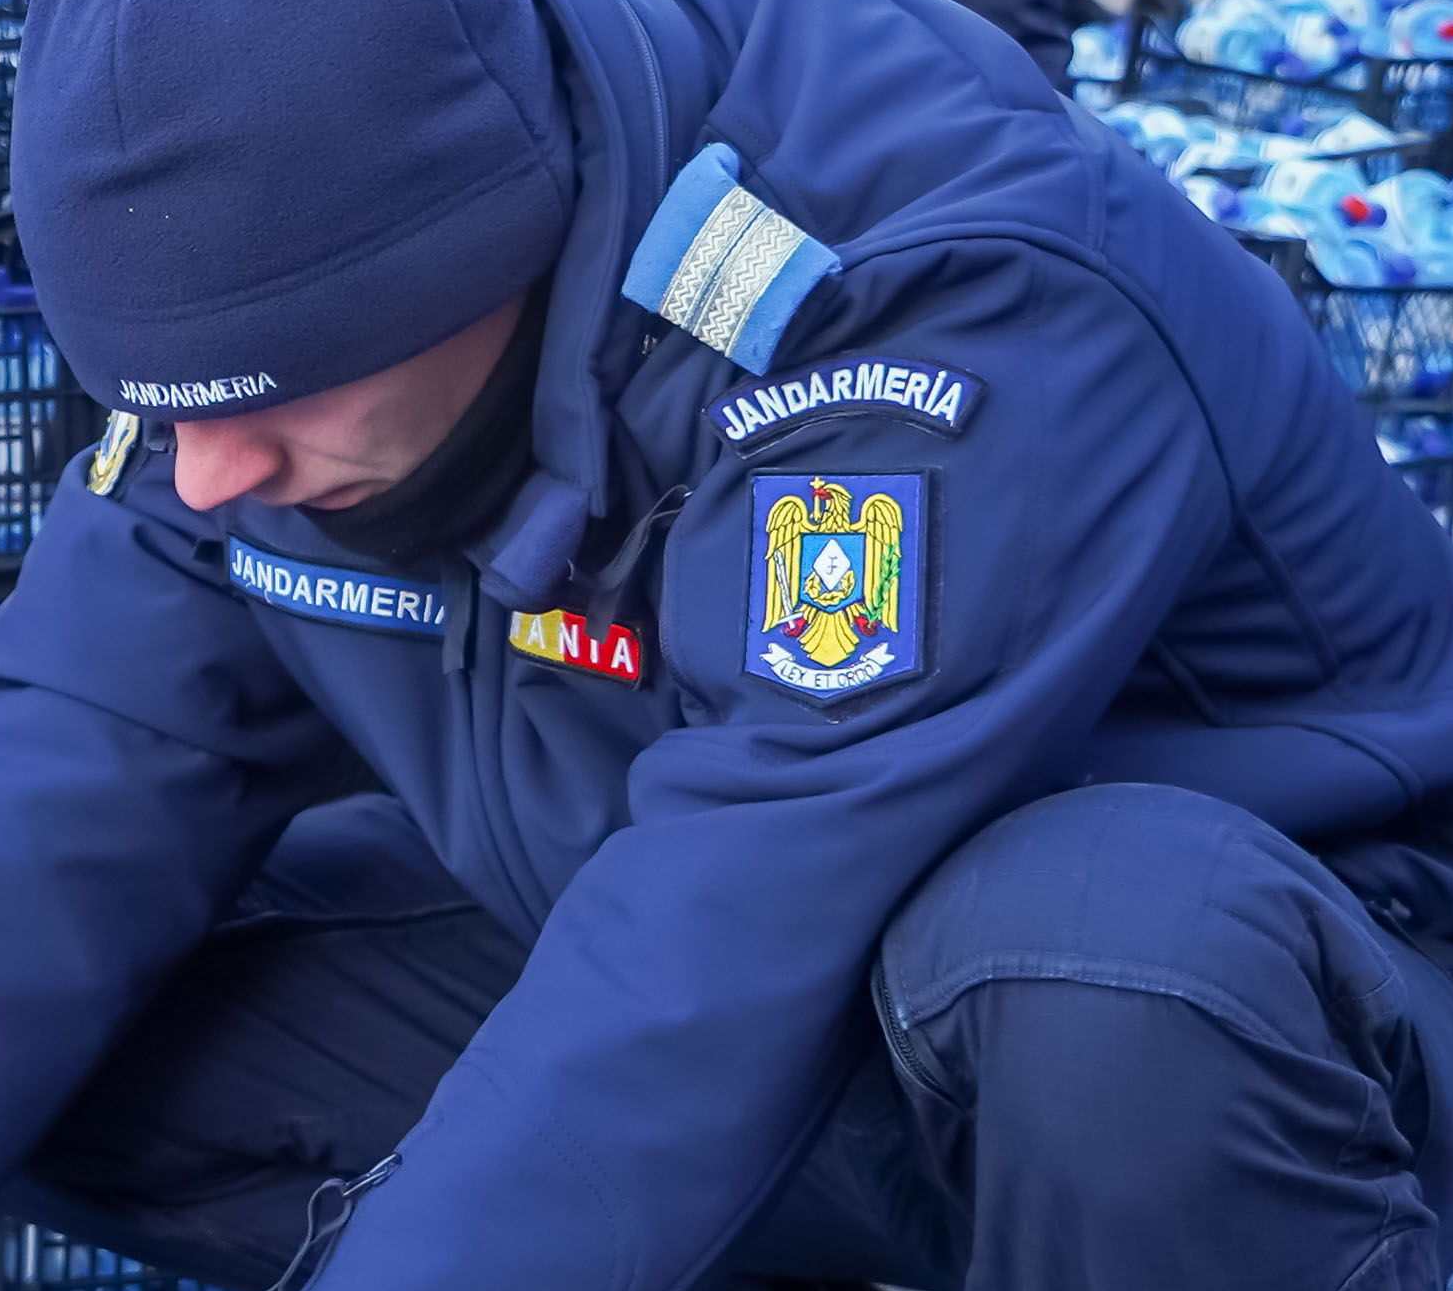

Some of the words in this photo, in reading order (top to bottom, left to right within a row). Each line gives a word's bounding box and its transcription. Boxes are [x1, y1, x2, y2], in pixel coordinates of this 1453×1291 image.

[119, 371, 277, 409] JANDARMERIA
[232, 549, 445, 625] JANDARMERI
[779, 661, 805, 685] LEX
[814, 669, 832, 688] ET
[837, 661, 877, 688] ORDO
